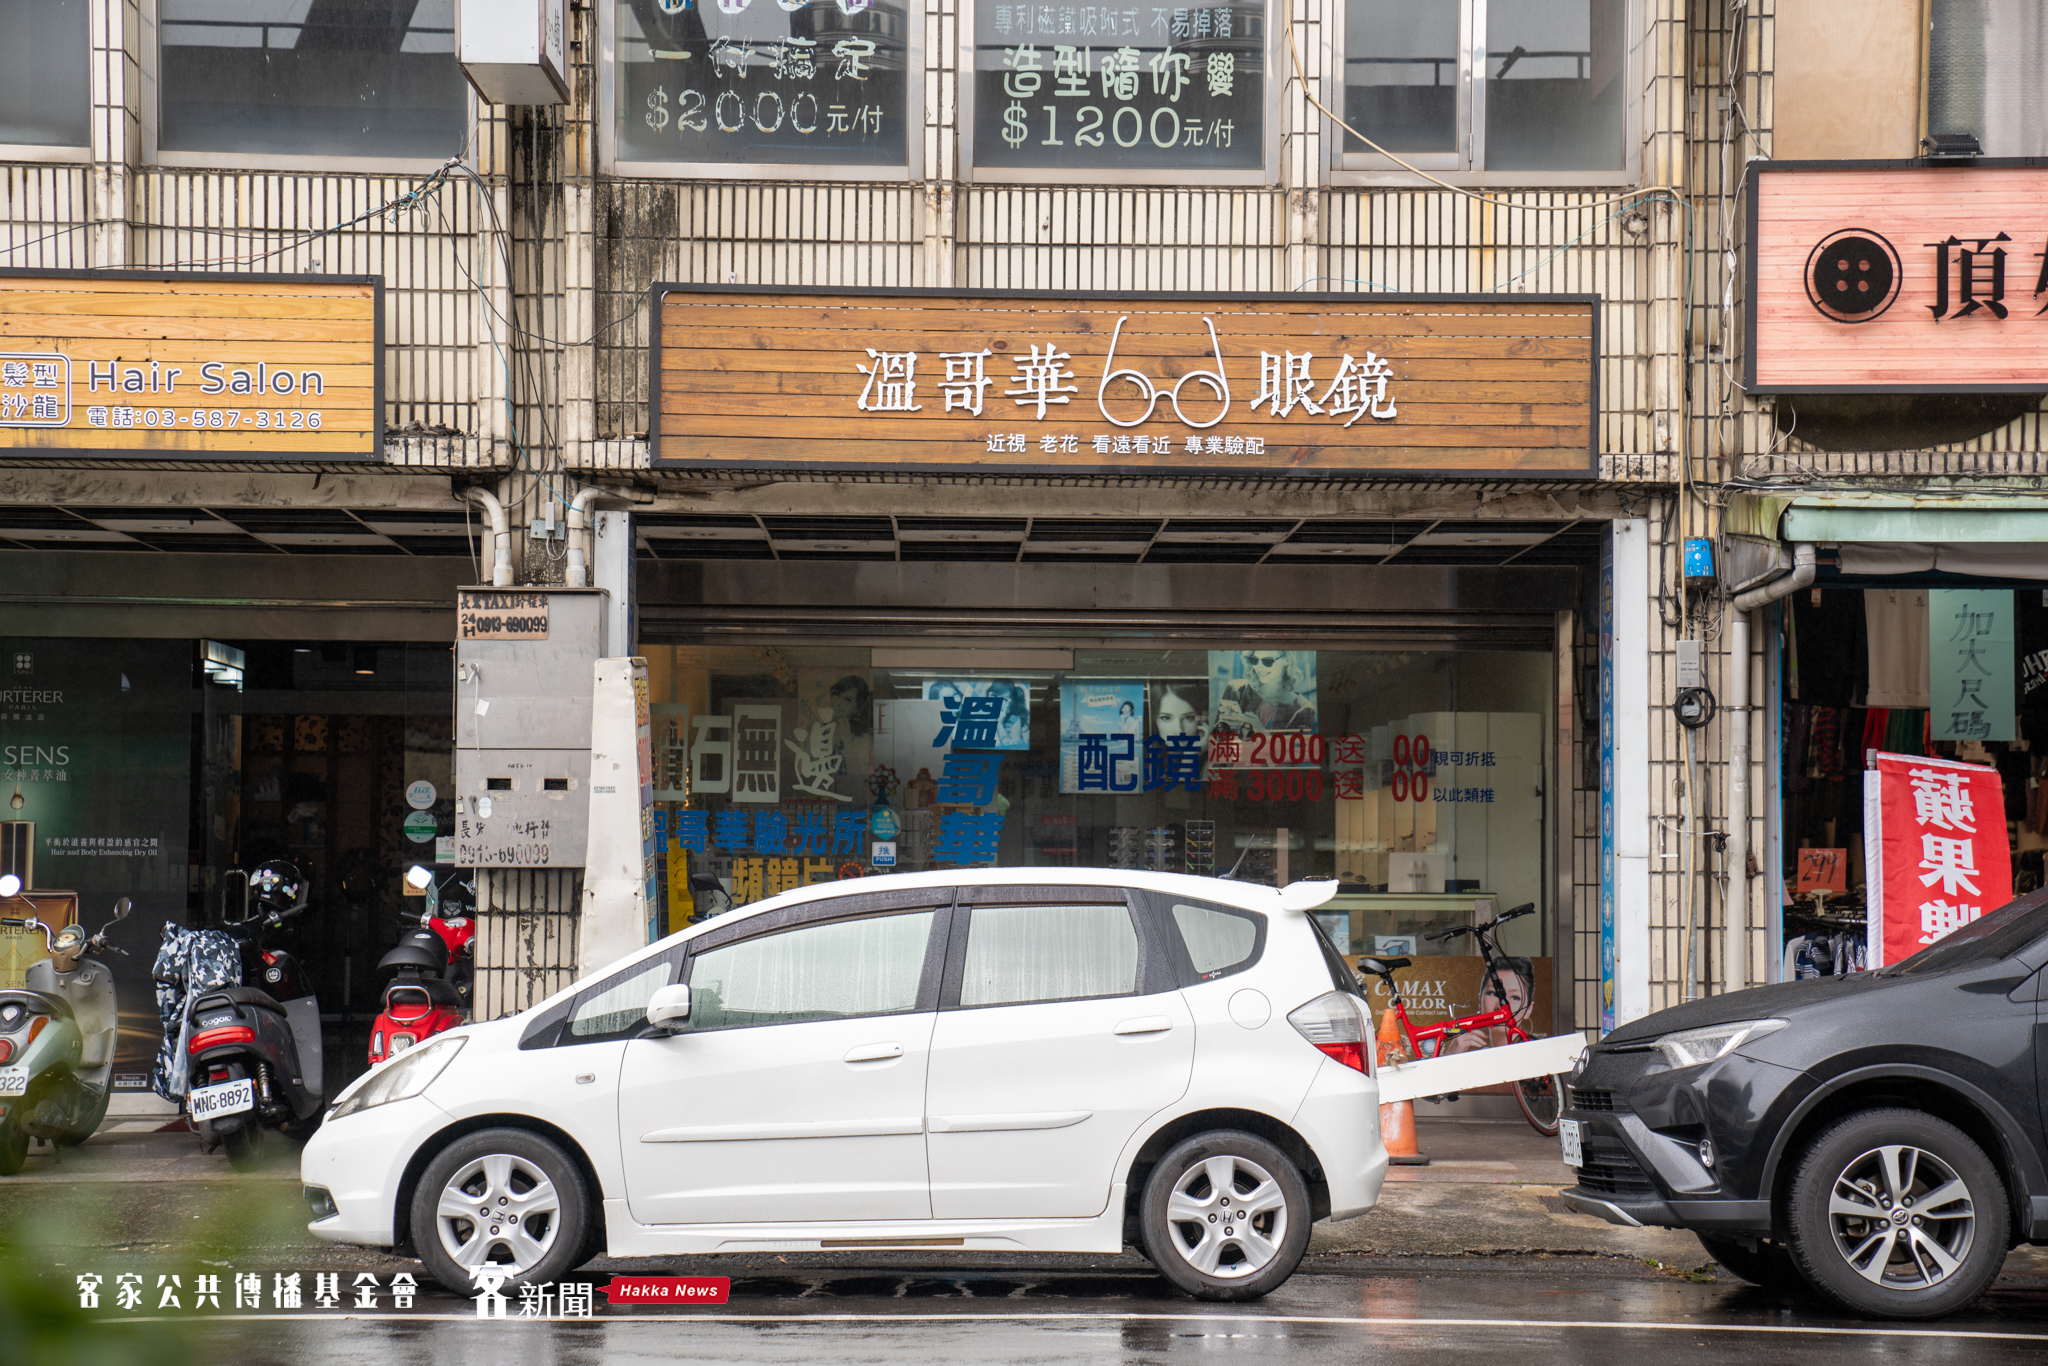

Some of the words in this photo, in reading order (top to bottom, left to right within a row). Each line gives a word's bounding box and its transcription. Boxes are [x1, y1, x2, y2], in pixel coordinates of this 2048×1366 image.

[995, 5, 1140, 36] 專利磁鐵吸附式
[1151, 7, 1233, 38] 不易掉落
[648, 35, 876, 80] 一付搞定
[1003, 43, 1234, 102] 造型隨你變
[1923, 231, 2048, 320] 頂
[2, 362, 58, 387] 髮型
[88, 360, 182, 395] Hair
[199, 361, 325, 396] Salon
[855, 342, 1079, 420] 溫哥華
[1250, 350, 1398, 428] 眼鏡
[2, 393, 59, 418] 沙龍
[986, 434, 1027, 453] 近視
[1039, 434, 1079, 454] 老花
[1092, 434, 1172, 455] 看遠看近
[1185, 435, 1265, 456] 專業驗配
[476, 616, 548, 633] 0913-690099
[1946, 604, 1995, 740] 加大尺碼
[3, 746, 70, 765] SENS
[1078, 732, 1203, 793] 配鏡
[1250, 732, 1325, 765] 2000
[1434, 751, 1496, 767] 現可折抵
[932, 696, 1006, 865] 溫哥華
[1247, 769, 1323, 801] 3000
[1433, 787, 1495, 803] 以此類推
[81, 849, 97, 857] Body
[98, 849, 133, 857] Enhancing
[134, 849, 147, 857] Dry
[878, 846, 890, 855] 推
[1802, 852, 1838, 884] 299
[193, 1087, 251, 1115] MNG-8892
